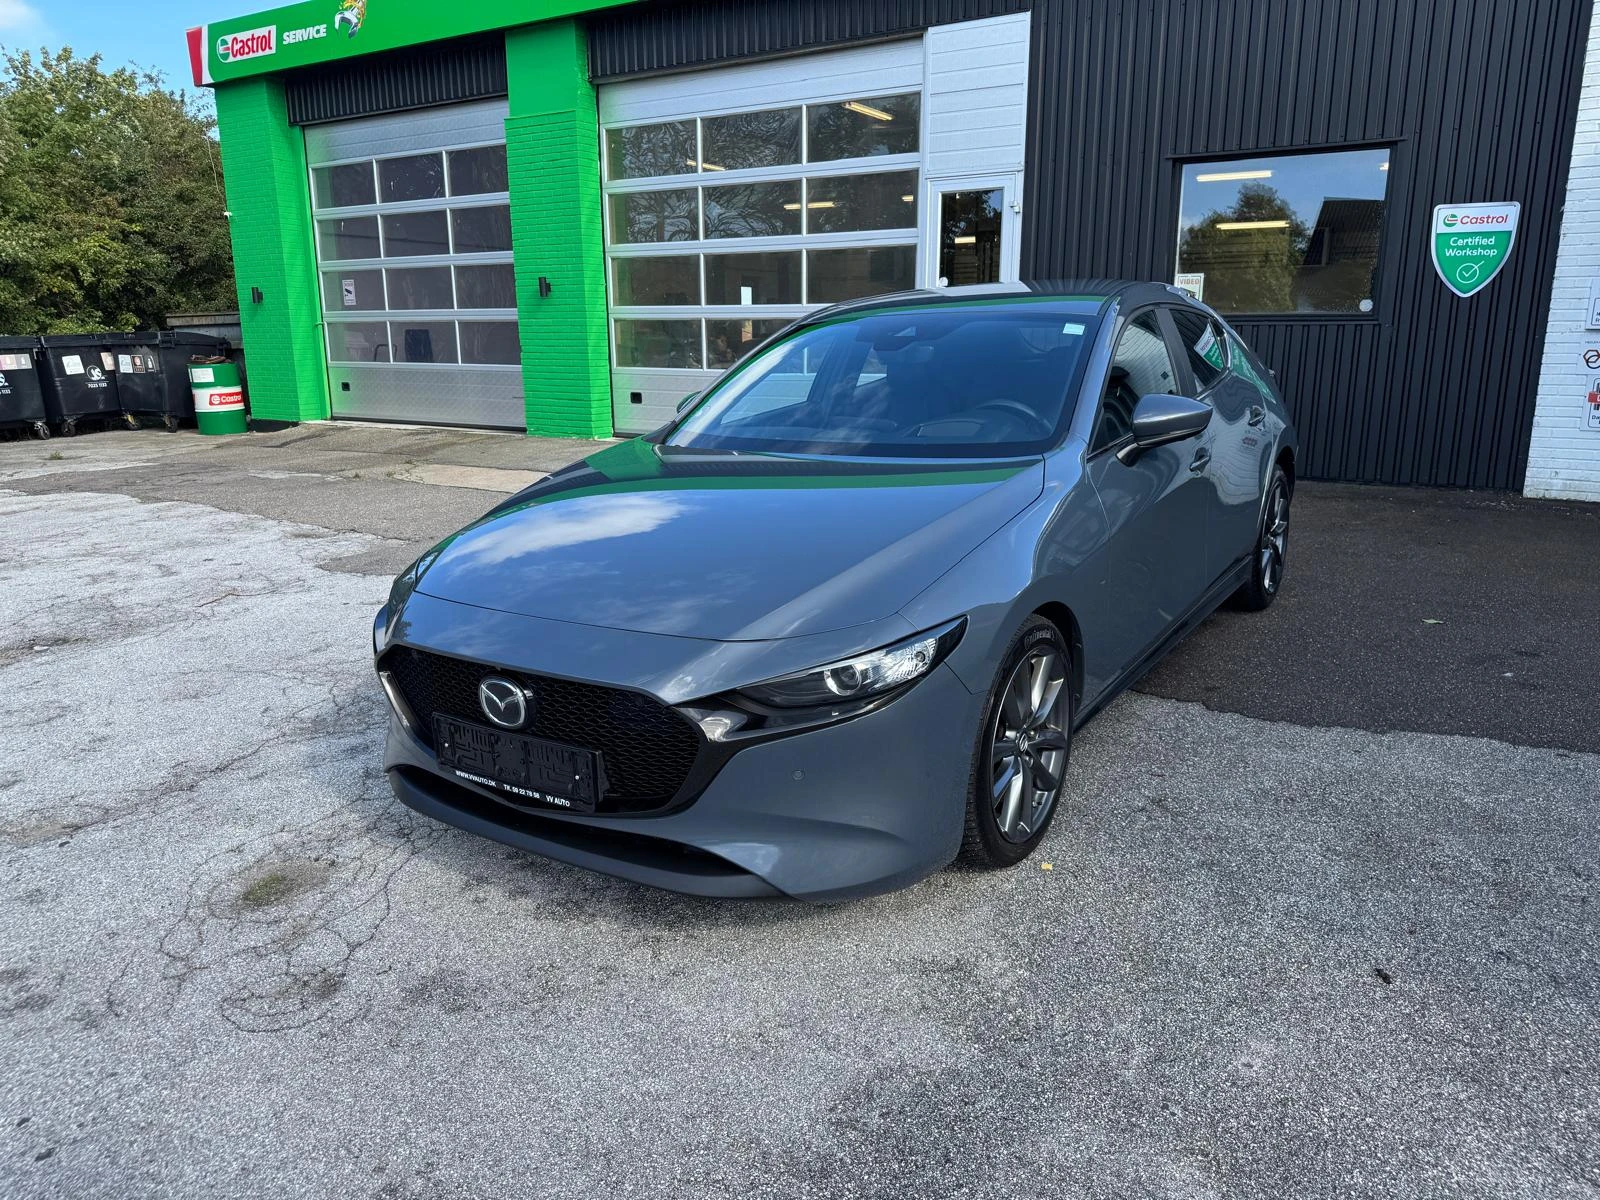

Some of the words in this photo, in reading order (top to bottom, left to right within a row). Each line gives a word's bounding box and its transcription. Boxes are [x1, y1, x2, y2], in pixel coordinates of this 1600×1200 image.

[282, 24, 327, 45] SERVICE
[231, 30, 273, 58] Castrol
[1460, 214, 1509, 225] Castrol
[1450, 236, 1495, 246] Certified
[1445, 247, 1497, 257] Workshop
[546, 795, 554, 803] VV
[554, 797, 570, 807] AUTO
